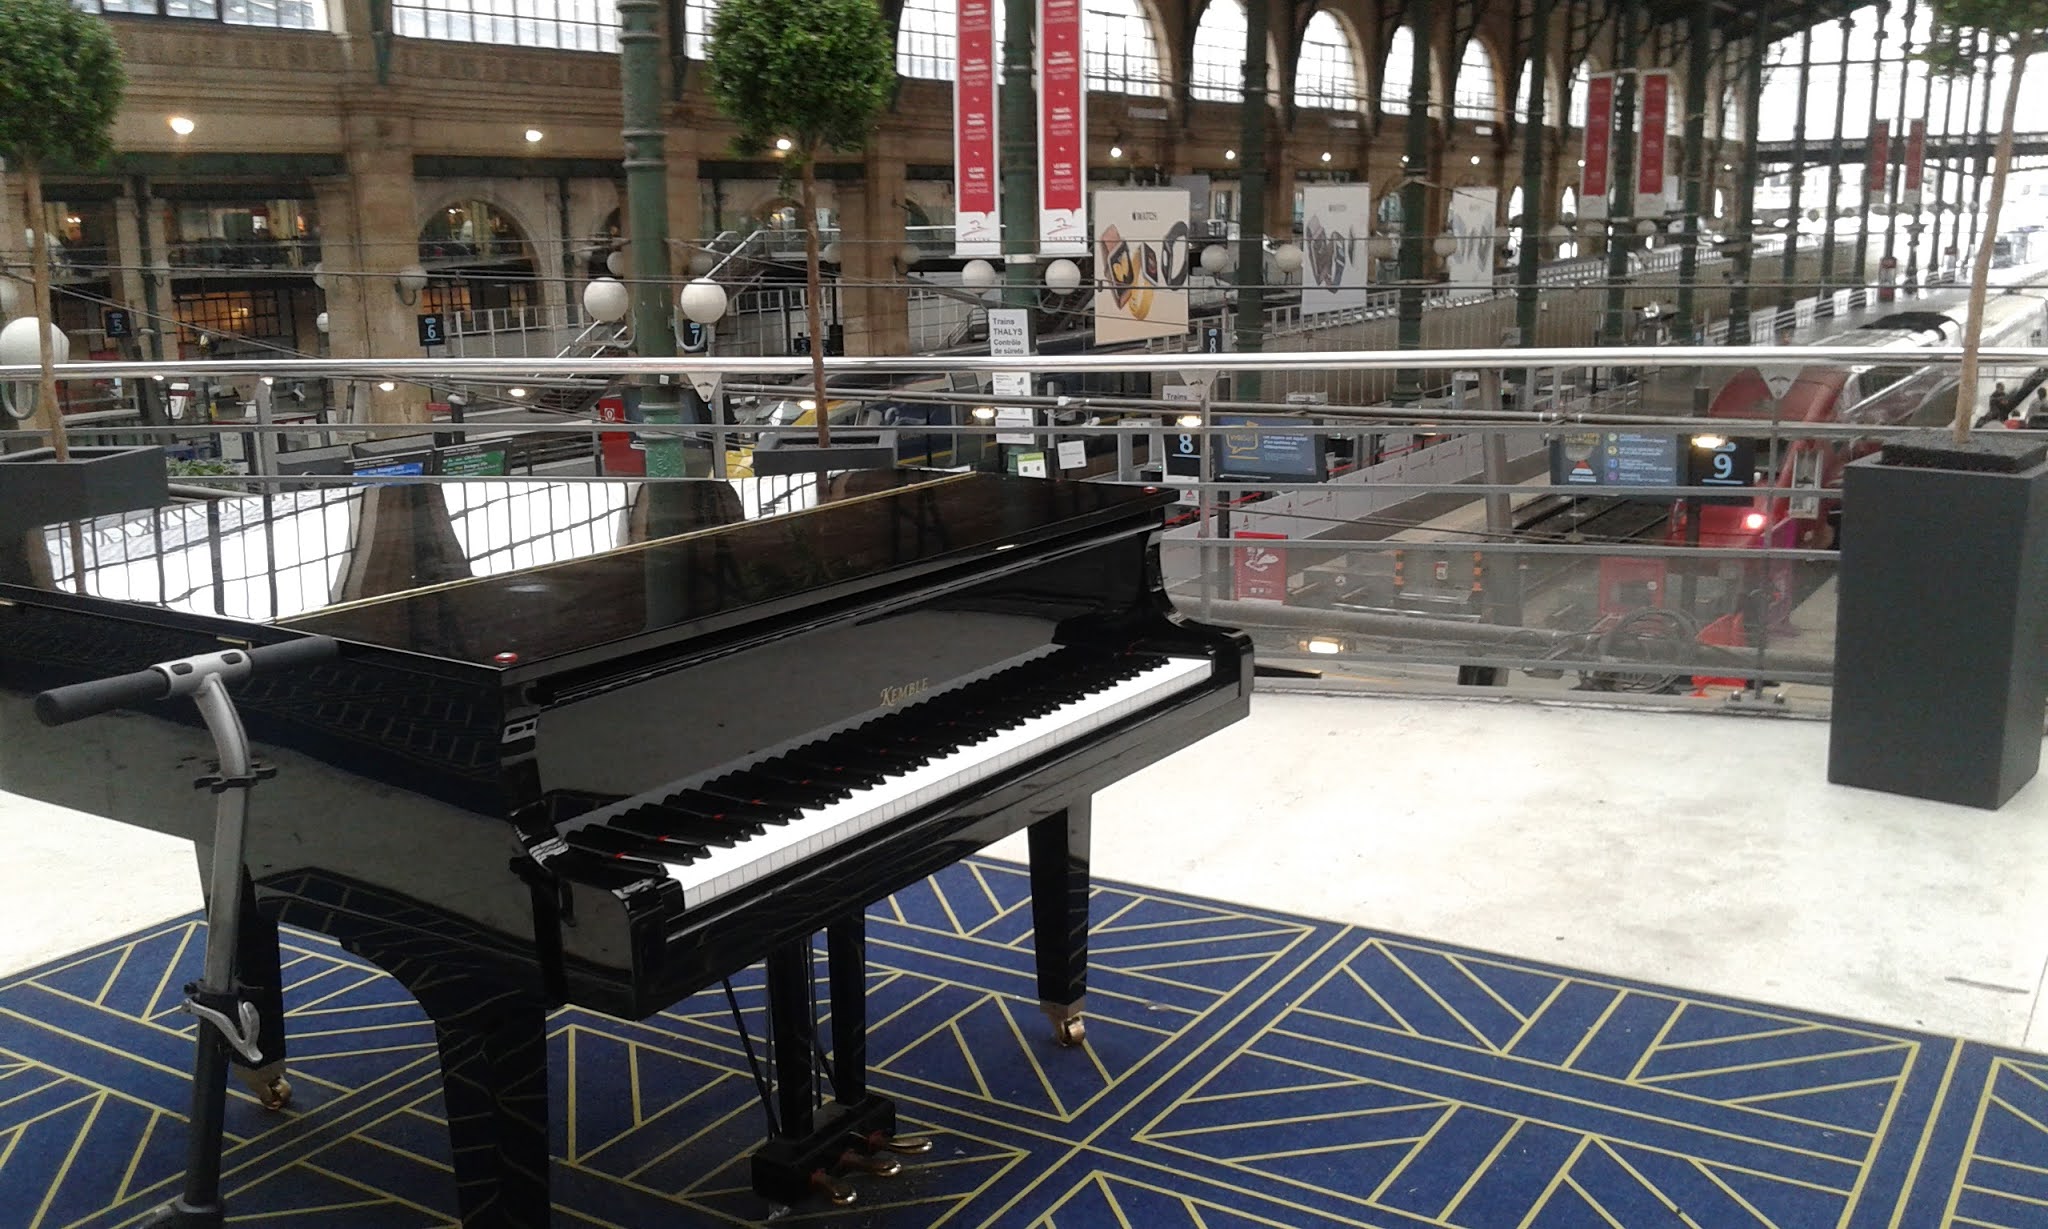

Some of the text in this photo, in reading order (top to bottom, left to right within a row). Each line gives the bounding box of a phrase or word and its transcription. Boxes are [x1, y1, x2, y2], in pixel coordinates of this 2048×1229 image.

[992, 317, 1015, 326] Trains
[427, 324, 437, 340] 6
[691, 329, 700, 345] 7
[993, 327, 1023, 336] THALYS
[993, 338, 1022, 347] Contrôle
[1166, 392, 1188, 401] Trains
[1178, 432, 1195, 454] 8
[1713, 453, 1733, 480] 9
[880, 677, 930, 707] KEMBLE
